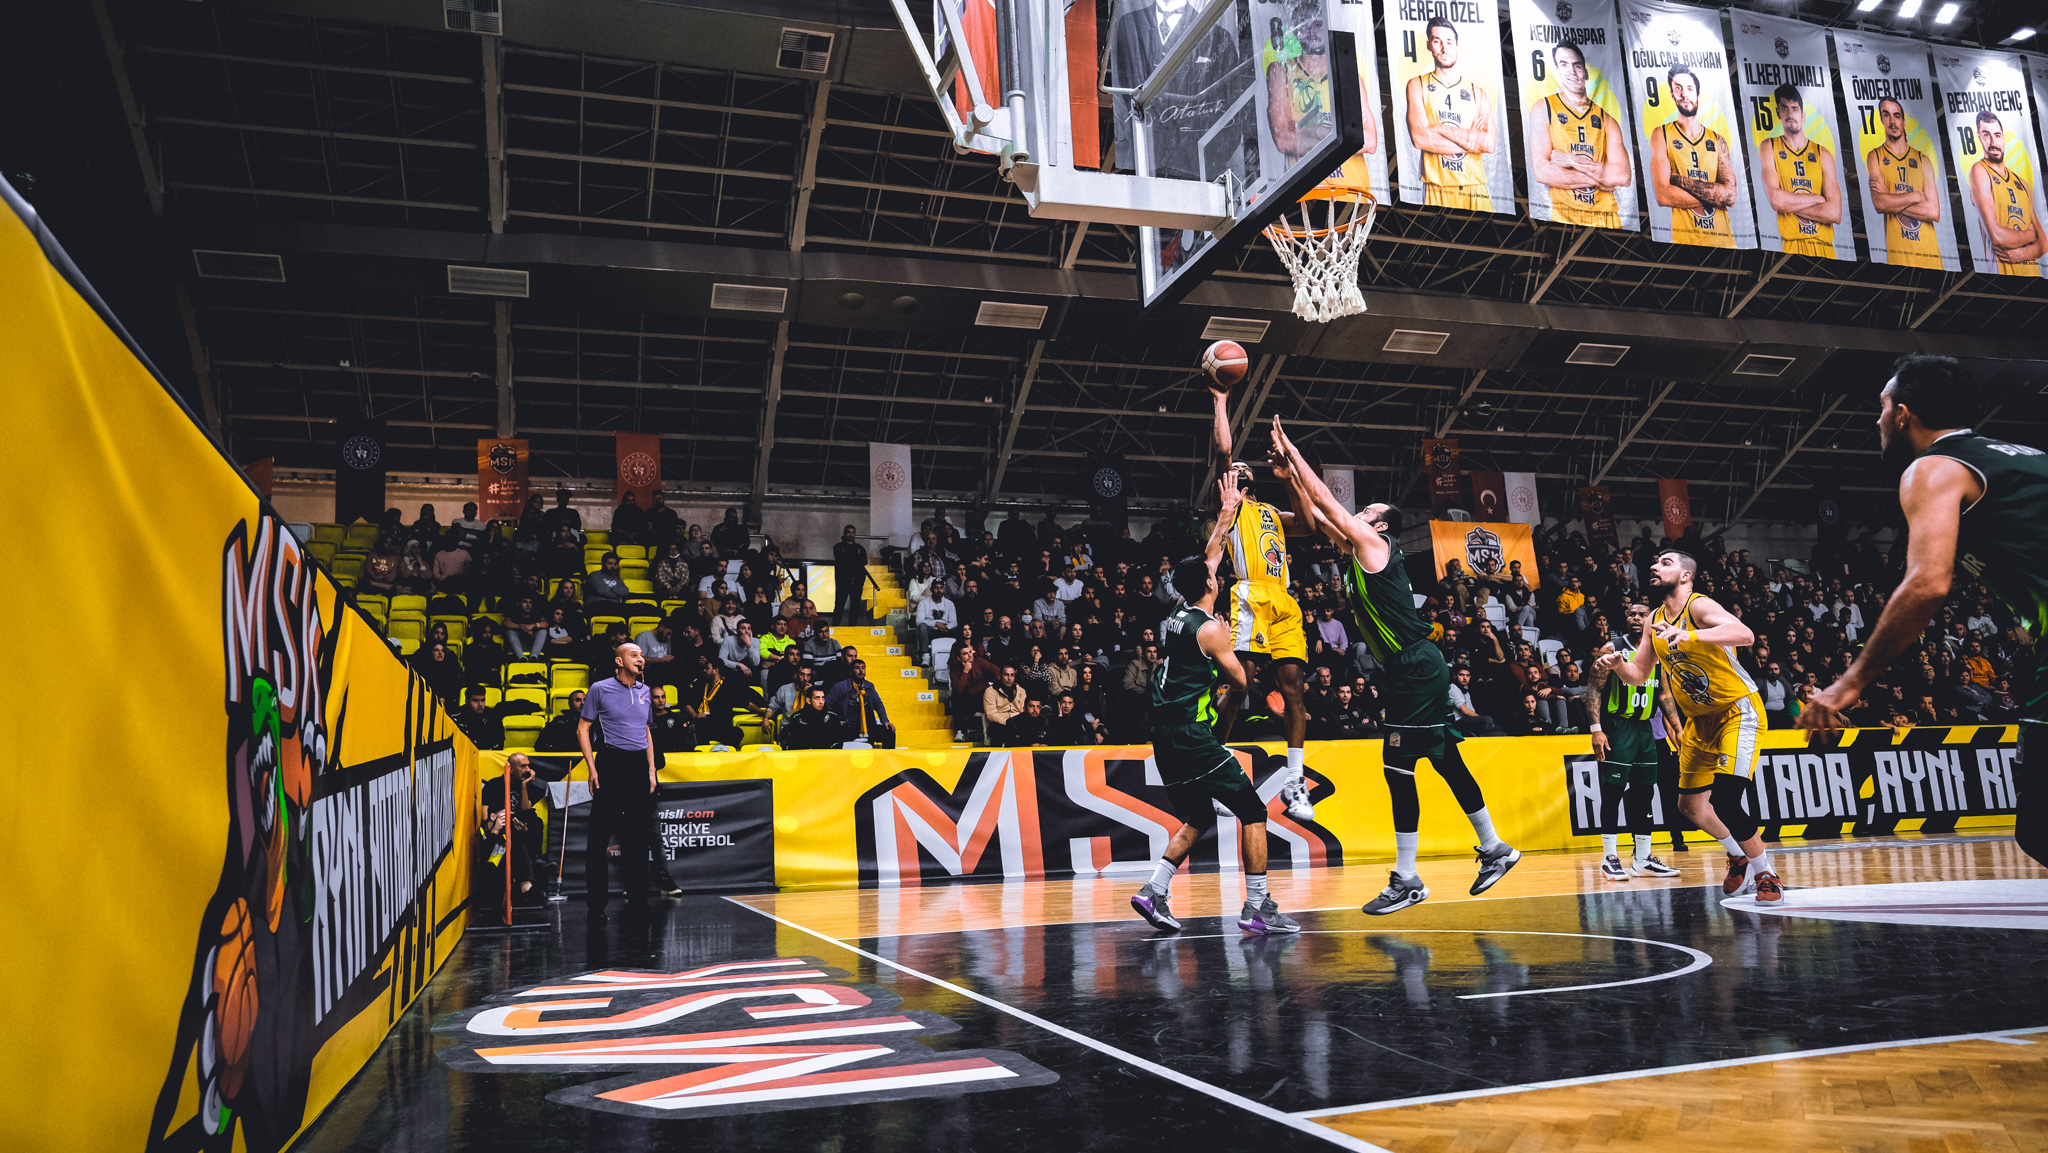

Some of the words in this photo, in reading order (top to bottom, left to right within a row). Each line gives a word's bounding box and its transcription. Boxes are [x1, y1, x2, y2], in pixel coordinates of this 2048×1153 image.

[1399, 0, 1448, 22] KEREM
[1530, 24, 1561, 43] KEVIN
[1562, 27, 1606, 45] KASPAR
[1403, 30, 1417, 63] 4
[1531, 49, 1545, 82] 6
[1743, 57, 1782, 86] İLKER
[1782, 64, 1825, 88] TUNALI
[1645, 76, 1660, 108] 9
[1851, 75, 1892, 101] ÖNDER
[1892, 78, 1924, 101] ATUN
[1444, 94, 1452, 111] 4
[1946, 91, 1993, 114] BERKAY
[1993, 90, 2023, 117] GENÇ
[1749, 96, 1774, 132] 15
[1857, 105, 1876, 135] 17
[1577, 125, 1586, 143] 6
[1956, 126, 1977, 155] 18
[1441, 156, 1463, 173] MSK
[1690, 150, 1700, 169] 9
[1793, 160, 1806, 177] 15
[1896, 166, 1906, 182] 17
[1573, 188, 1596, 206] MSK
[1693, 214, 1715, 230] MSK
[1798, 223, 1819, 235] MSK
[1900, 226, 1921, 242] MSK
[490, 457, 516, 467] MSK
[1469, 549, 1501, 564] MSK
[226, 515, 325, 733] MSK
[1631, 692, 1649, 708] 00
[873, 749, 1328, 883] MSK
[660, 821, 711, 836] ÜRKİYE
[662, 835, 736, 848] ASKETBOL
[466, 958, 1020, 1110] MSK
